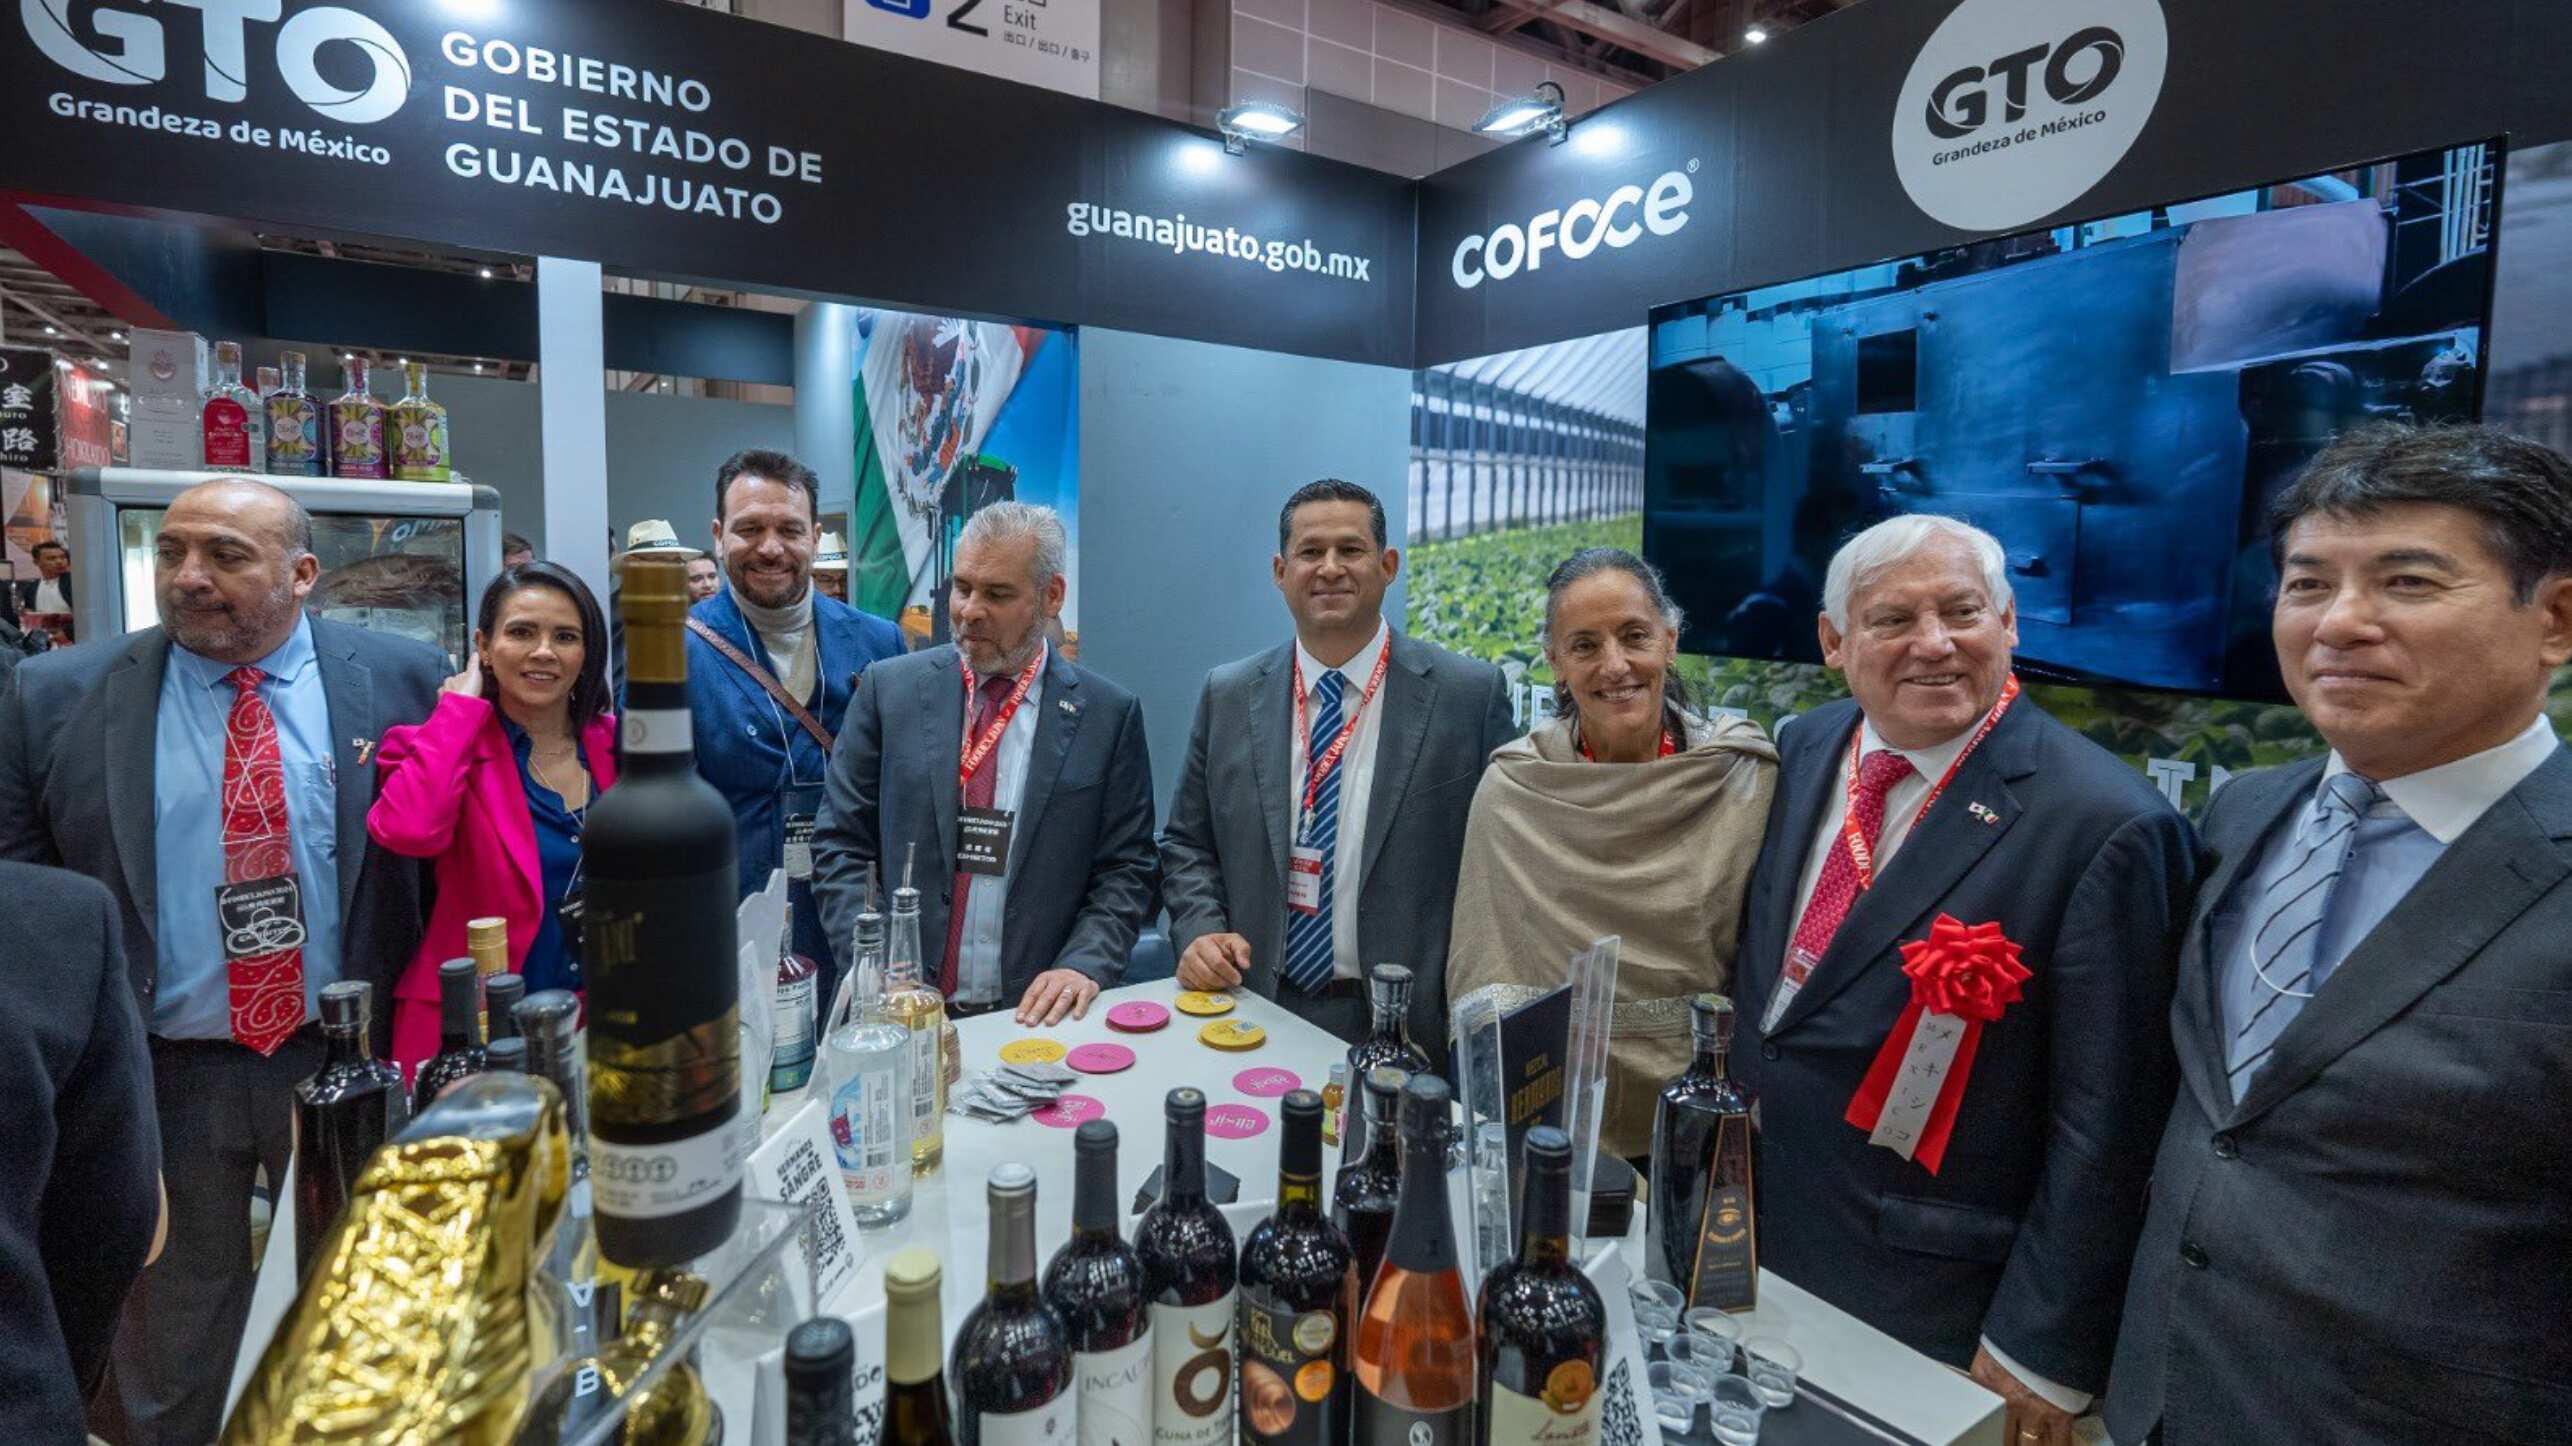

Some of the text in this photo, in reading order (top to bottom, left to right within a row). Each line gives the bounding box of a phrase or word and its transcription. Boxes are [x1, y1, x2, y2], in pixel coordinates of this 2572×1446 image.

[1003, 5, 1037, 31] Exit
[441, 31, 711, 113] GOBIERNO
[1924, 25, 2125, 140] GTO
[48, 92, 391, 166] Grandeza de México
[444, 85, 823, 184] DEL ESTADO DE
[1932, 108, 2107, 166] Grandeza de México
[444, 142, 783, 225] GUANAJUATO
[1065, 200, 1371, 284] guanajuato.gob.mx
[2, 427, 39, 452] 路
[779, 1152, 823, 1201] SANGRE
